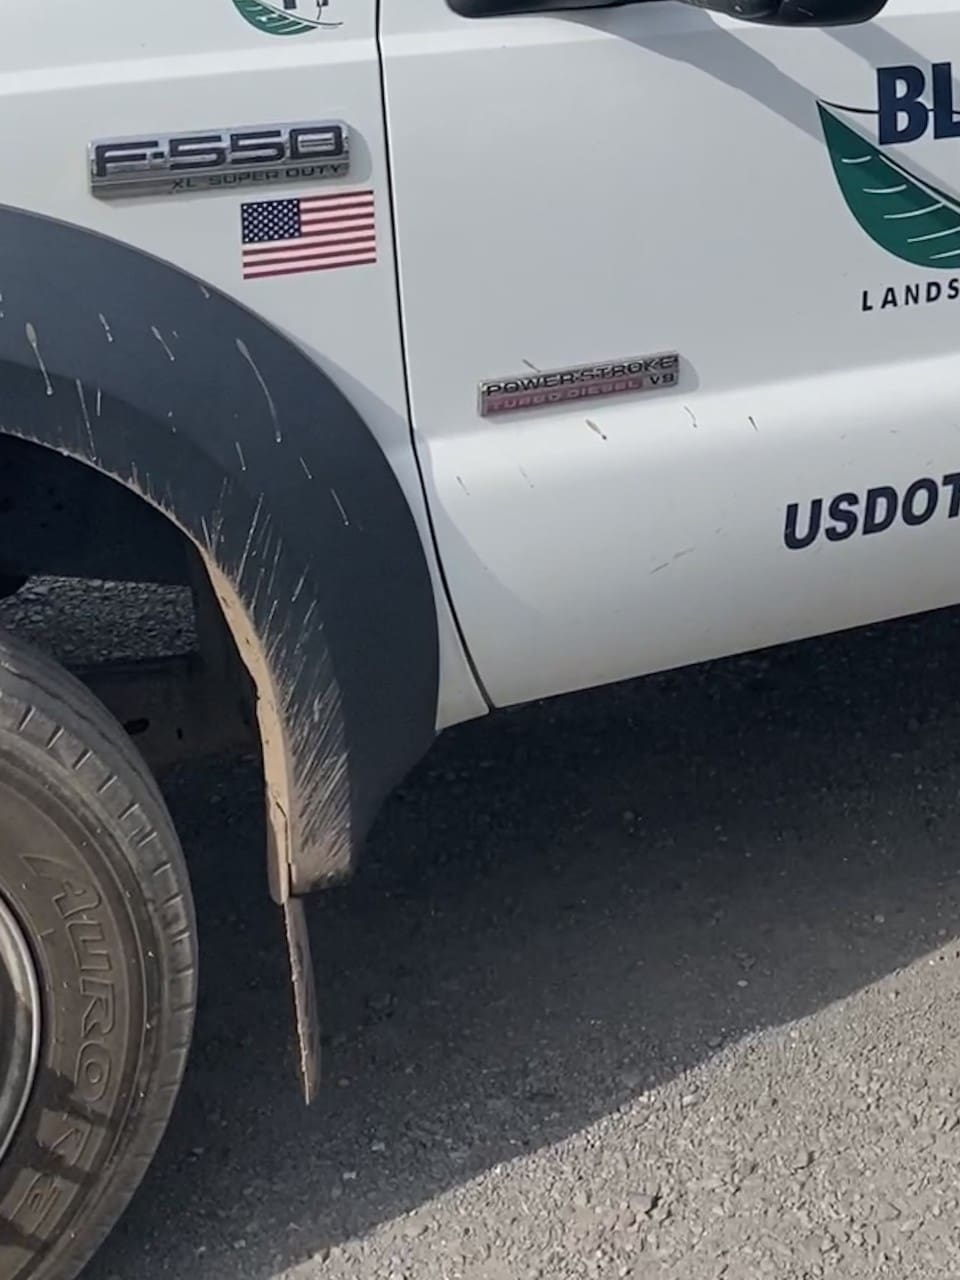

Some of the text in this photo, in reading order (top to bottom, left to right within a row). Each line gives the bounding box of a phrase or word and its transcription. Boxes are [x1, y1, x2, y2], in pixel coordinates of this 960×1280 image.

[94, 125, 344, 177] F-550
[172, 164, 343, 190] XL SUPER DUTY
[490, 373, 675, 411] TURBO DIESEL V8
